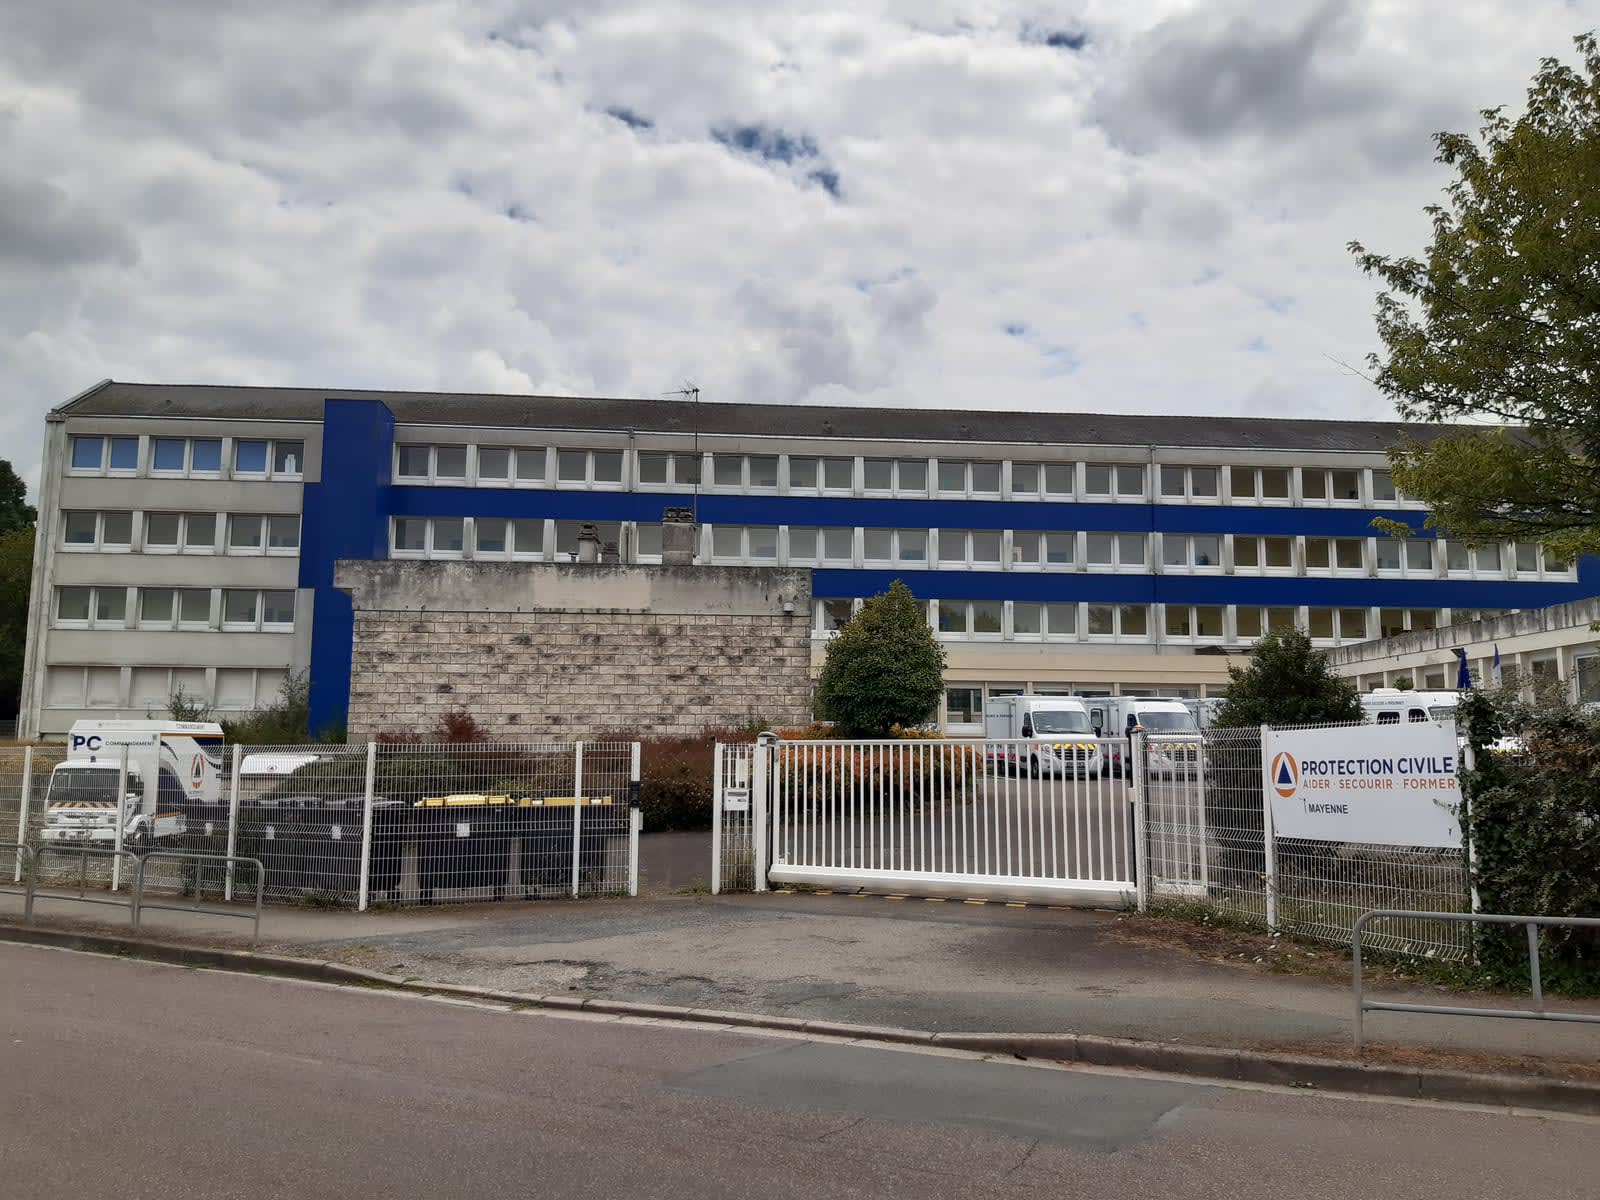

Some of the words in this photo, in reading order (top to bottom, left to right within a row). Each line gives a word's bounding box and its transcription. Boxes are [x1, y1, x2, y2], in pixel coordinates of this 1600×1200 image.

[73, 735, 101, 751] PC
[1301, 758, 1393, 776] PROTECTION
[1397, 756, 1454, 774] CIVILE
[1303, 779, 1330, 789] AIDER
[1339, 779, 1393, 789] SECOURIR
[1403, 778, 1456, 789] FORMER
[1308, 803, 1349, 814] MAYENNE
